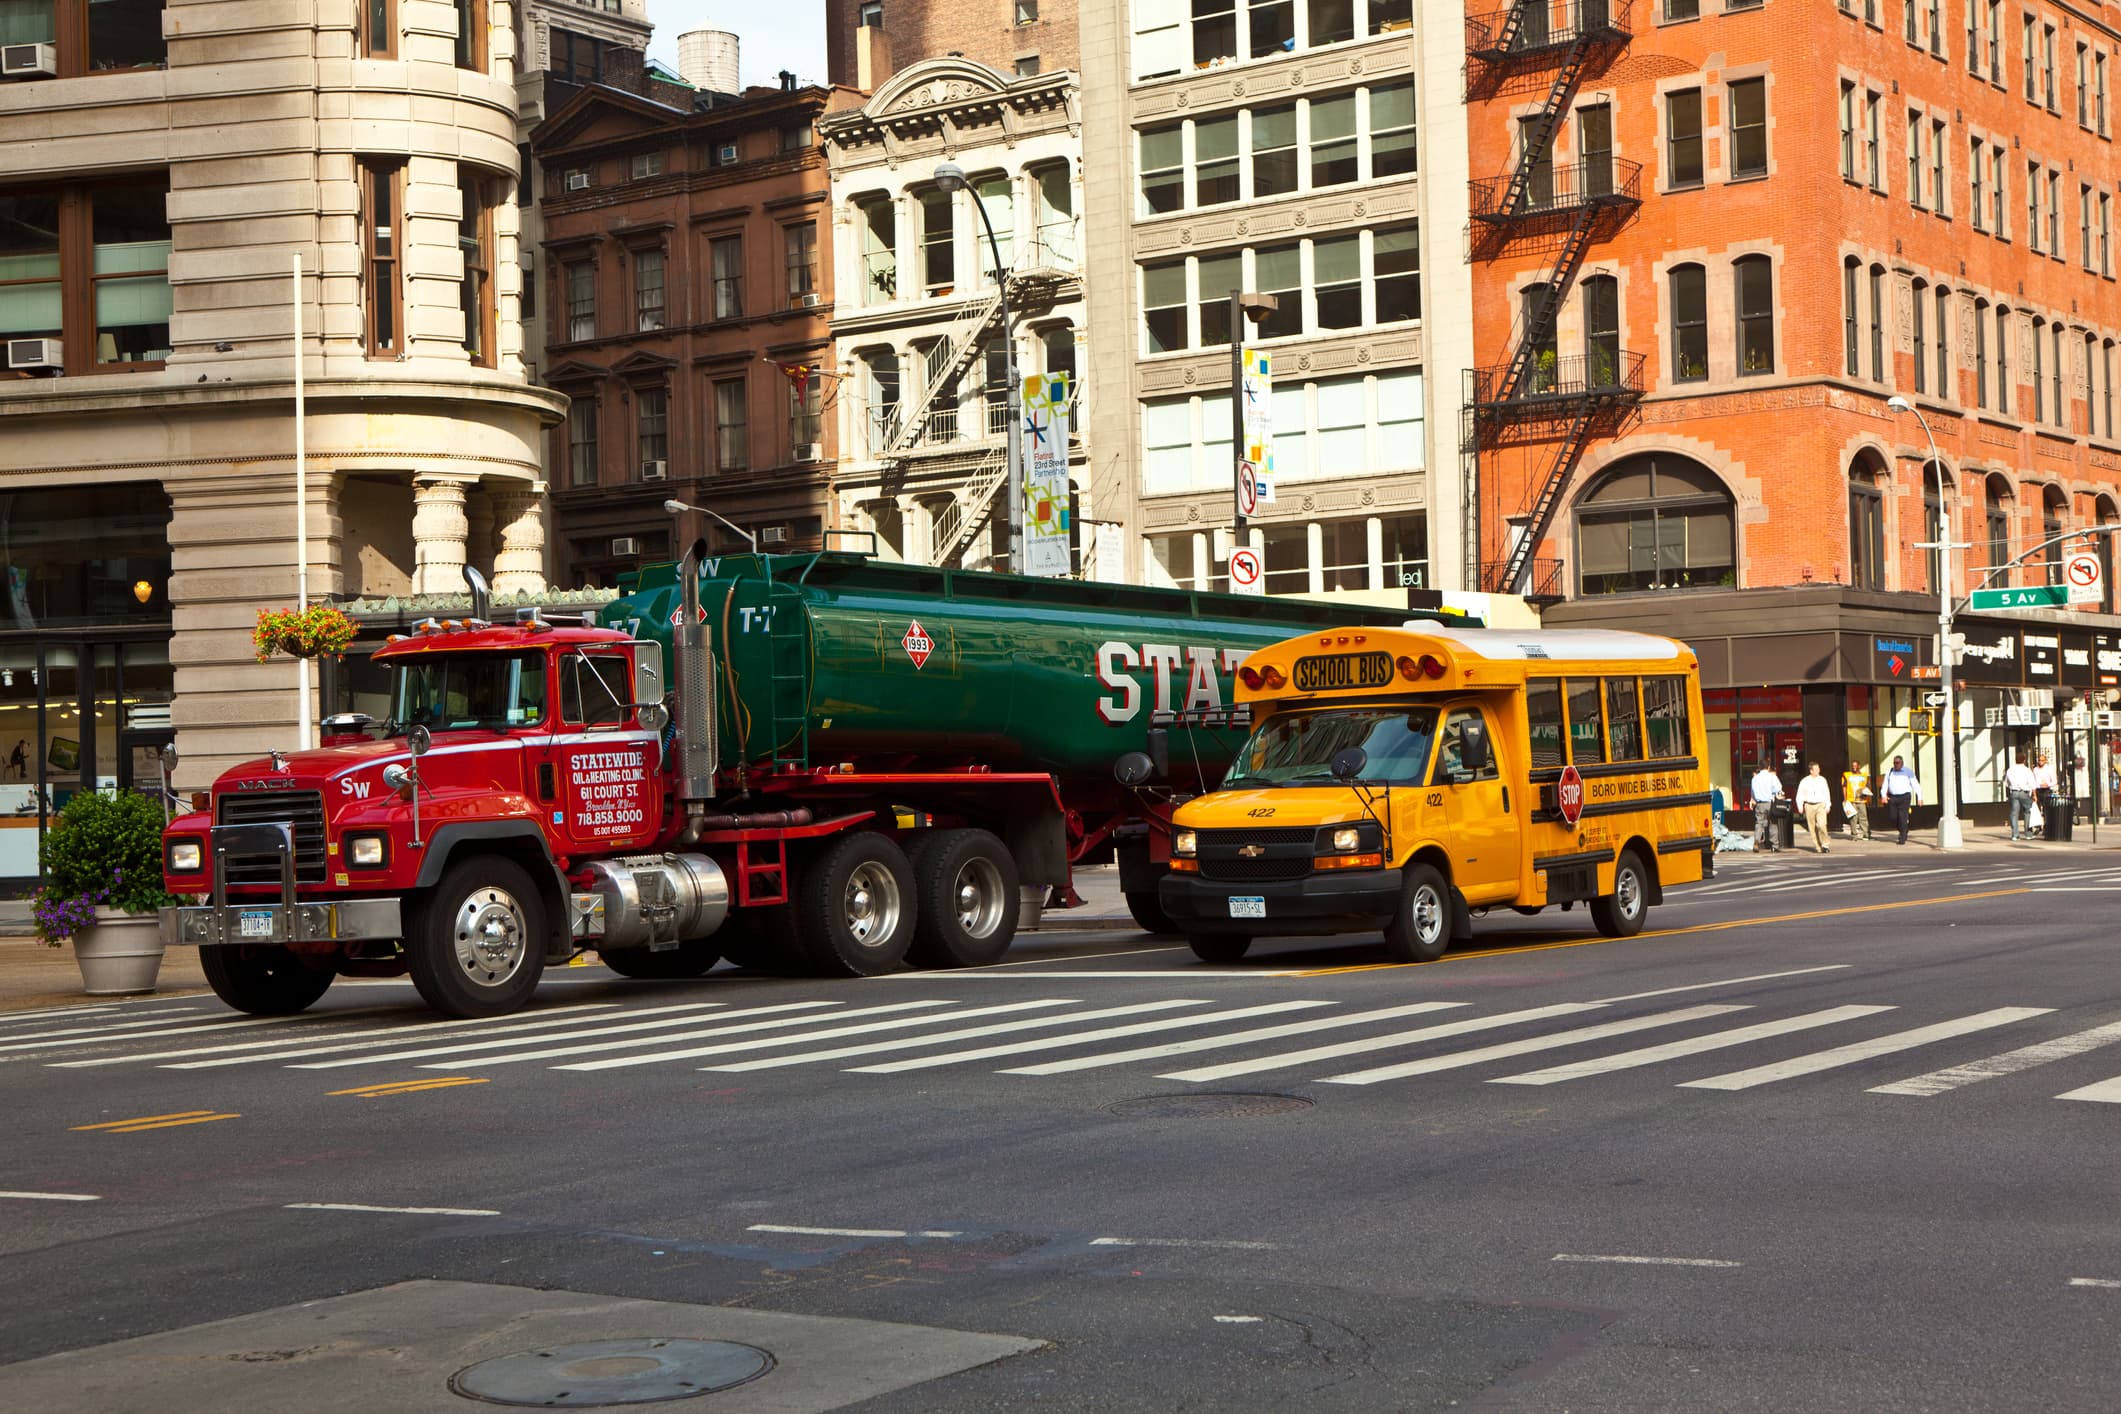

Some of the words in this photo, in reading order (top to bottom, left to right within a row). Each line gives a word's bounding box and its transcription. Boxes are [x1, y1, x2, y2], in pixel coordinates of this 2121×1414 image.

[1034, 460, 1048, 470] 23rd
[1049, 459, 1066, 468] Street
[2002, 593, 2011, 604] 5
[2017, 593, 2036, 604] Av
[740, 606, 777, 633] T-7
[908, 638, 928, 651] 1993
[1300, 658, 1354, 687] SCHOOL
[1360, 656, 1386, 683] BUS
[1914, 668, 1920, 678] 5
[571, 751, 643, 770] STATEWIDE
[237, 778, 296, 790] MACK
[573, 772, 585, 784] OIL
[590, 770, 621, 784] HEATING
[341, 777, 370, 799] SW
[581, 787, 592, 800] 611
[594, 785, 624, 799] COURT
[626, 784, 638, 797] ST.
[1562, 784, 1580, 805] STOP
[1592, 783, 1617, 798] BORO
[1617, 781, 1639, 796] WIDE
[1640, 778, 1667, 793] BUSES
[1668, 776, 1683, 790] INC.
[1427, 793, 1443, 807] 422
[577, 809, 643, 826] 718.858.9000
[1247, 808, 1276, 818] 422
